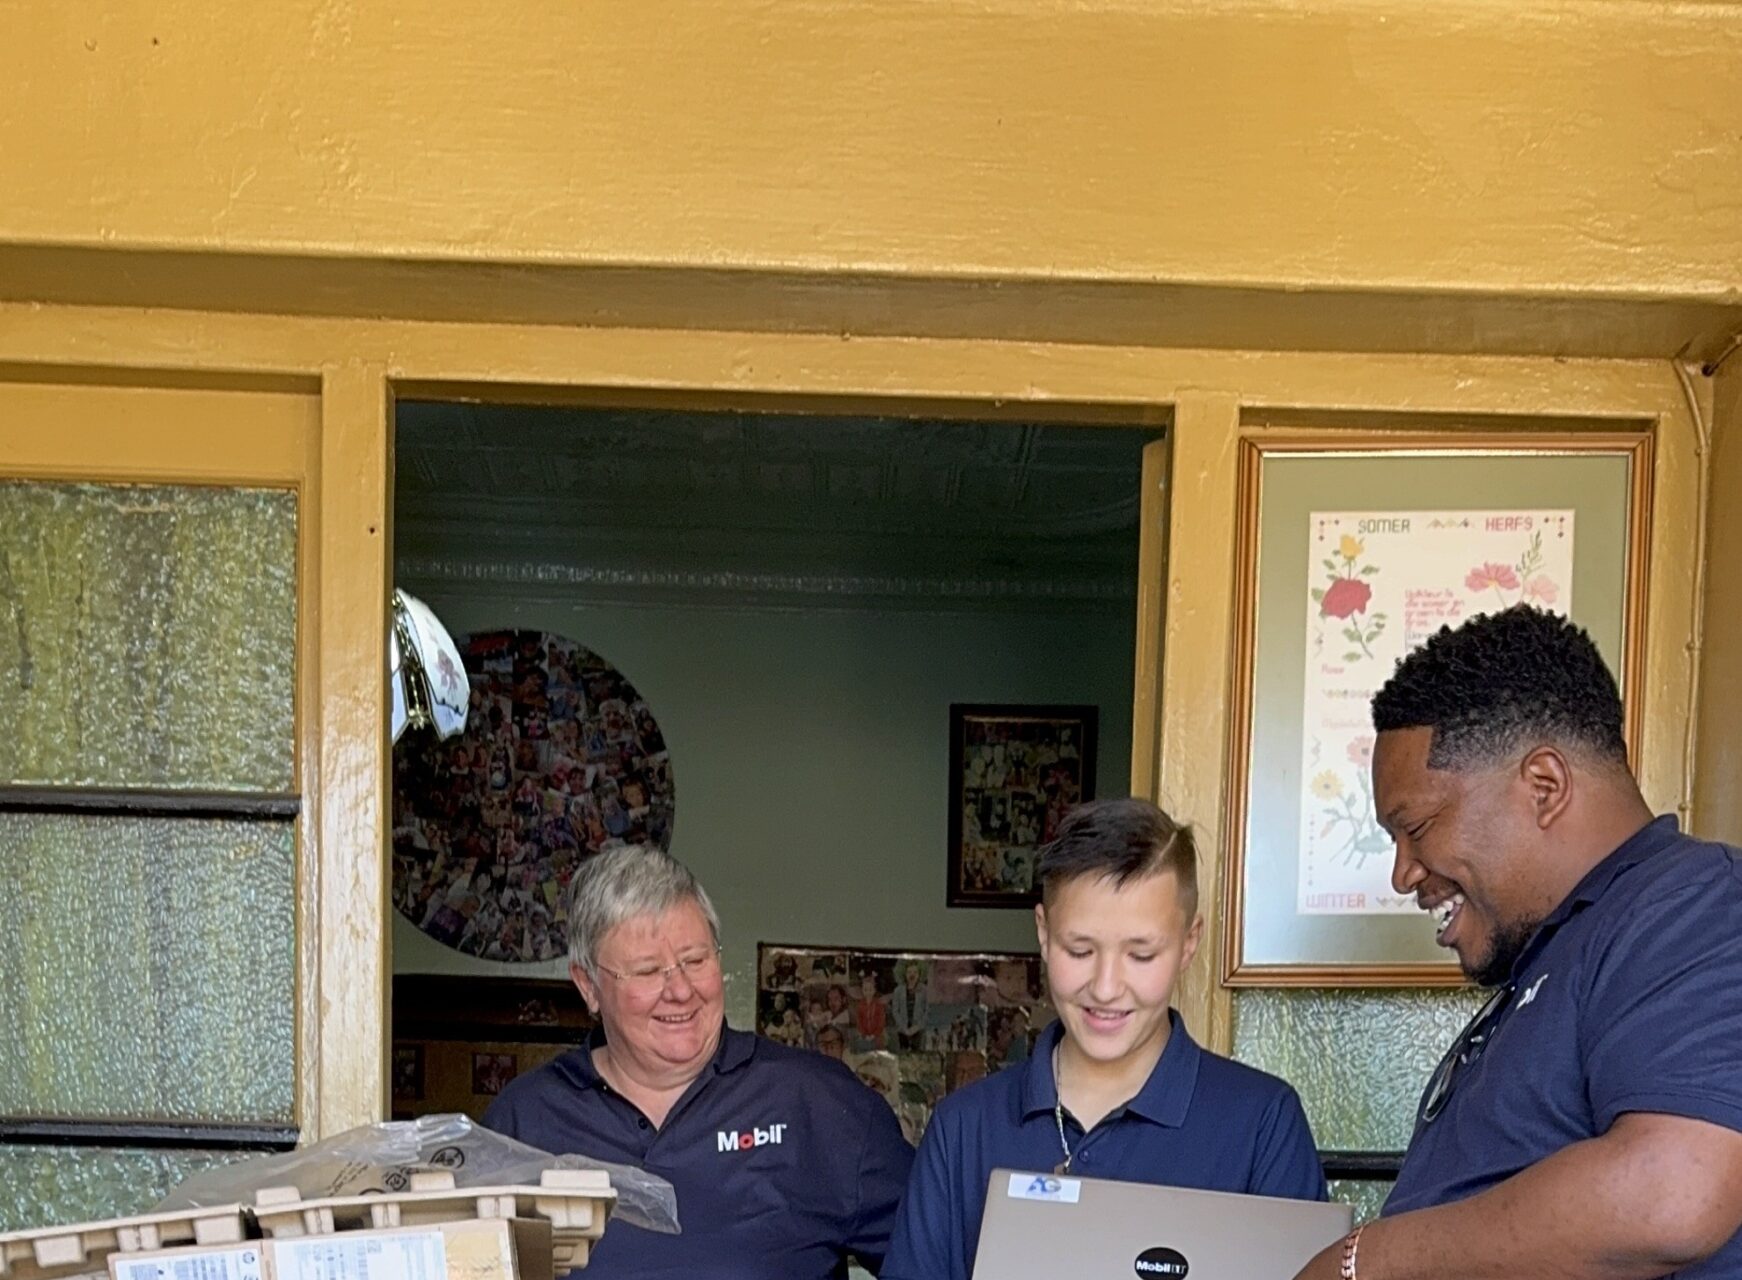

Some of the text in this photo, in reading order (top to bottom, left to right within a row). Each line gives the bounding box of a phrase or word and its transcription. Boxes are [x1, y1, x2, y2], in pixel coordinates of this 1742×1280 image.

[1358, 516, 1533, 534] SOMER HERFS
[1305, 892, 1366, 909] WINTER
[1136, 1260, 1171, 1274] Mobil
